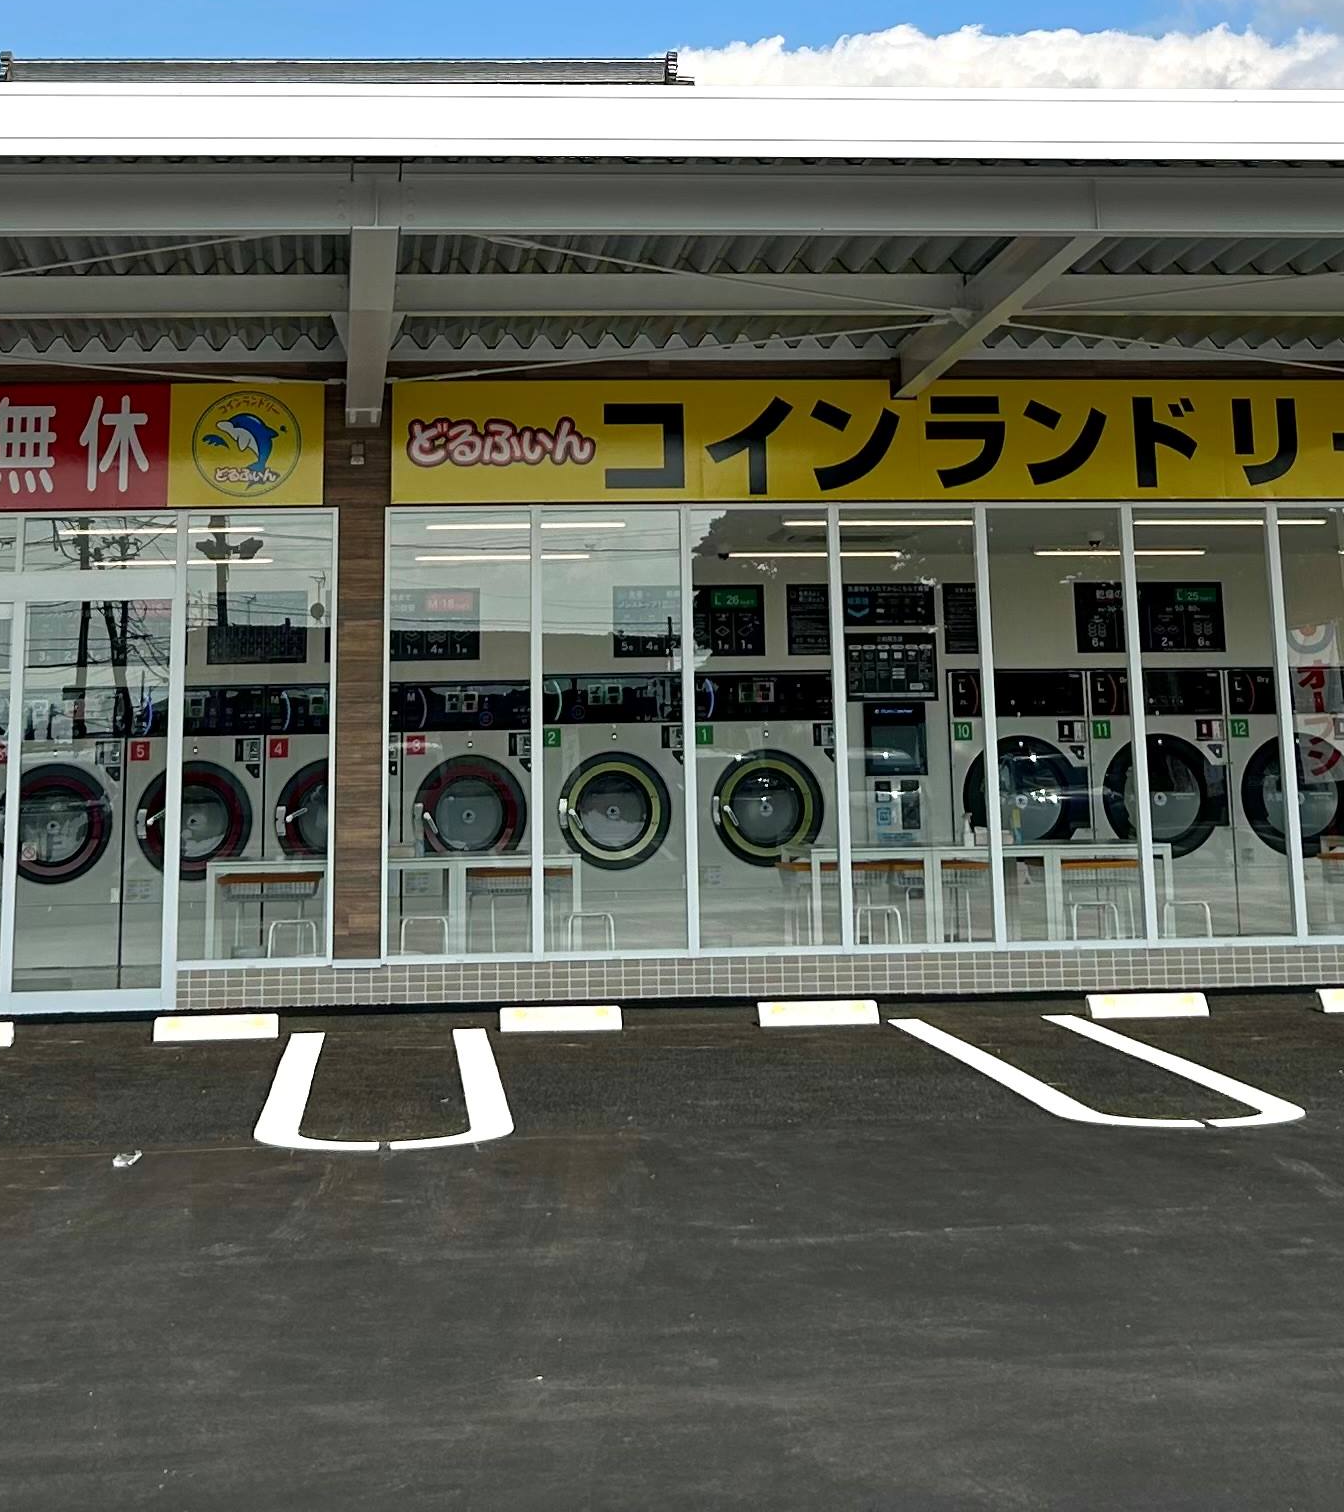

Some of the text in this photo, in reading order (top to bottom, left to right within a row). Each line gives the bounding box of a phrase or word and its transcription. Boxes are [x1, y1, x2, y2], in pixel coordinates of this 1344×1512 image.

[700, 728, 707, 742] 1
[957, 724, 970, 738] 10
[1096, 723, 1108, 737] 11
[1233, 721, 1247, 735] 12
[547, 730, 556, 745] 2
[135, 744, 145, 758] 5
[274, 744, 283, 755] 4
